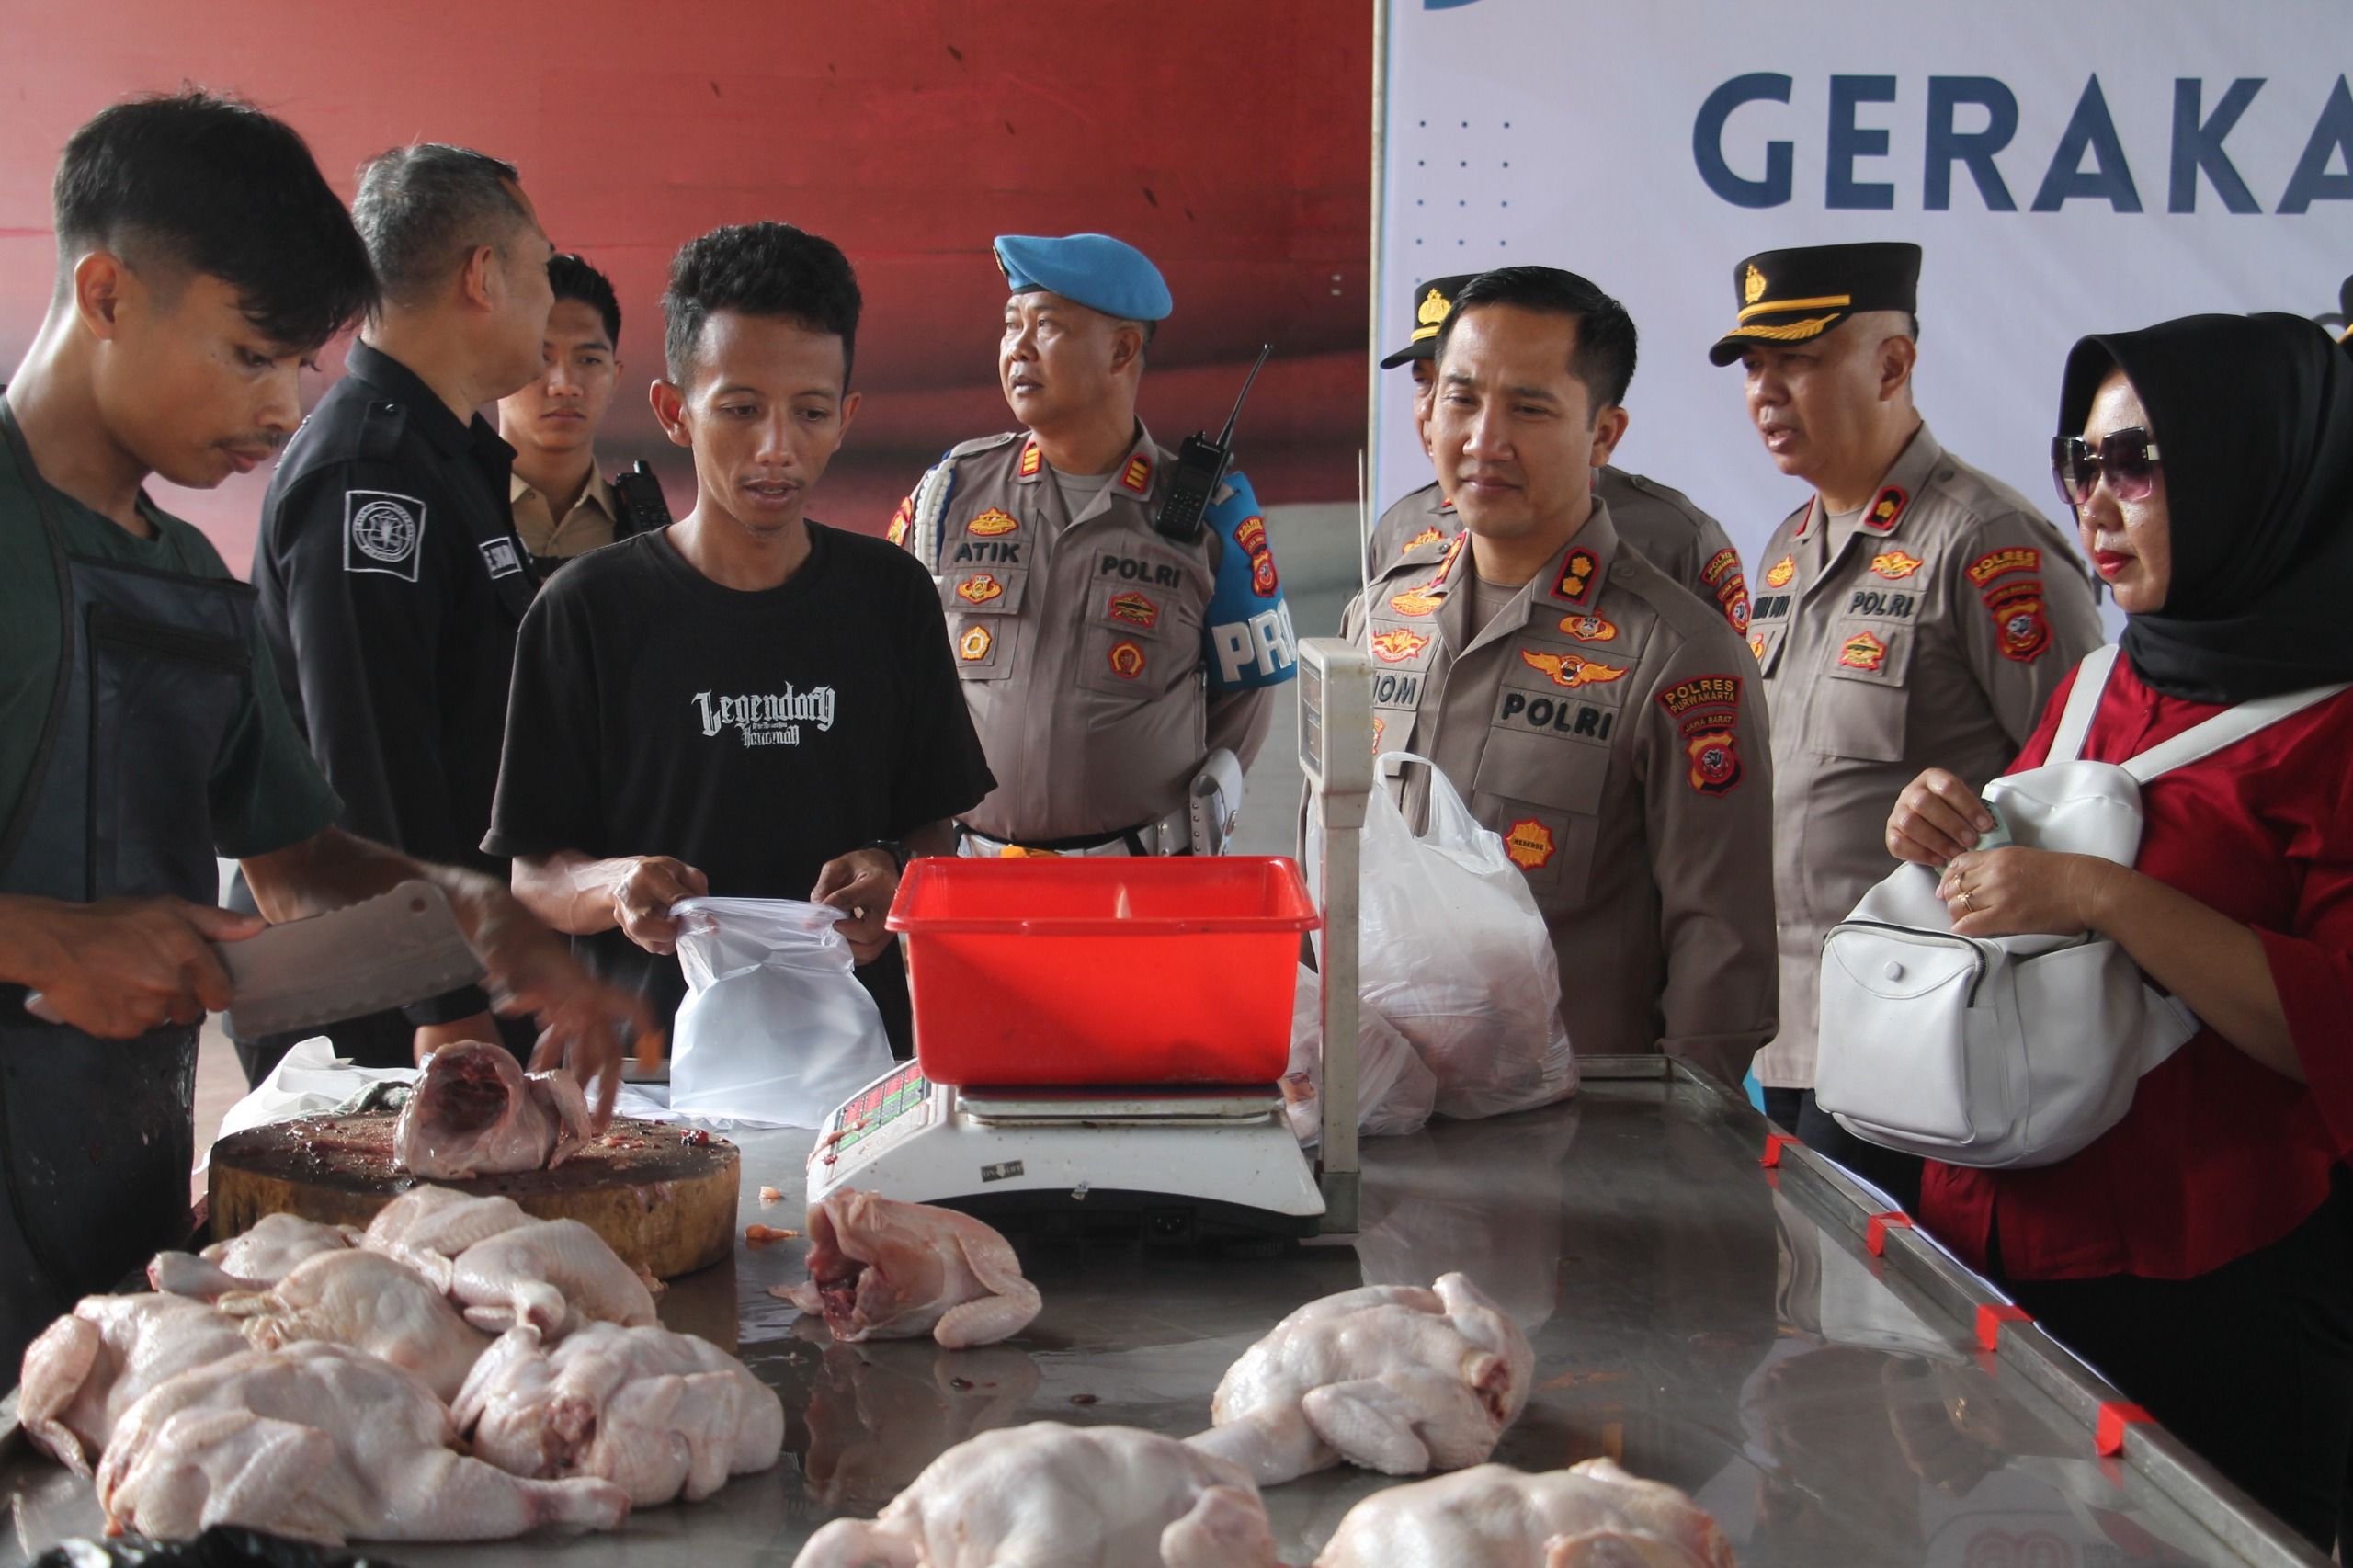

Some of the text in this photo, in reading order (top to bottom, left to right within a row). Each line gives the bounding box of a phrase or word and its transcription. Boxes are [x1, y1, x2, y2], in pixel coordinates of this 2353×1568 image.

[1693, 72, 2353, 214] GERAKA
[954, 543, 1021, 562] ATIK
[1970, 551, 2035, 576] POLRES
[1101, 555, 1180, 588] POLRI
[1849, 592, 1915, 618] POLRI
[1665, 679, 1733, 704] POLRES
[1670, 691, 1735, 714] PURWAKARTA
[1501, 693, 1613, 741] POLRI
[1685, 715, 1733, 732] JAWA BARAT
